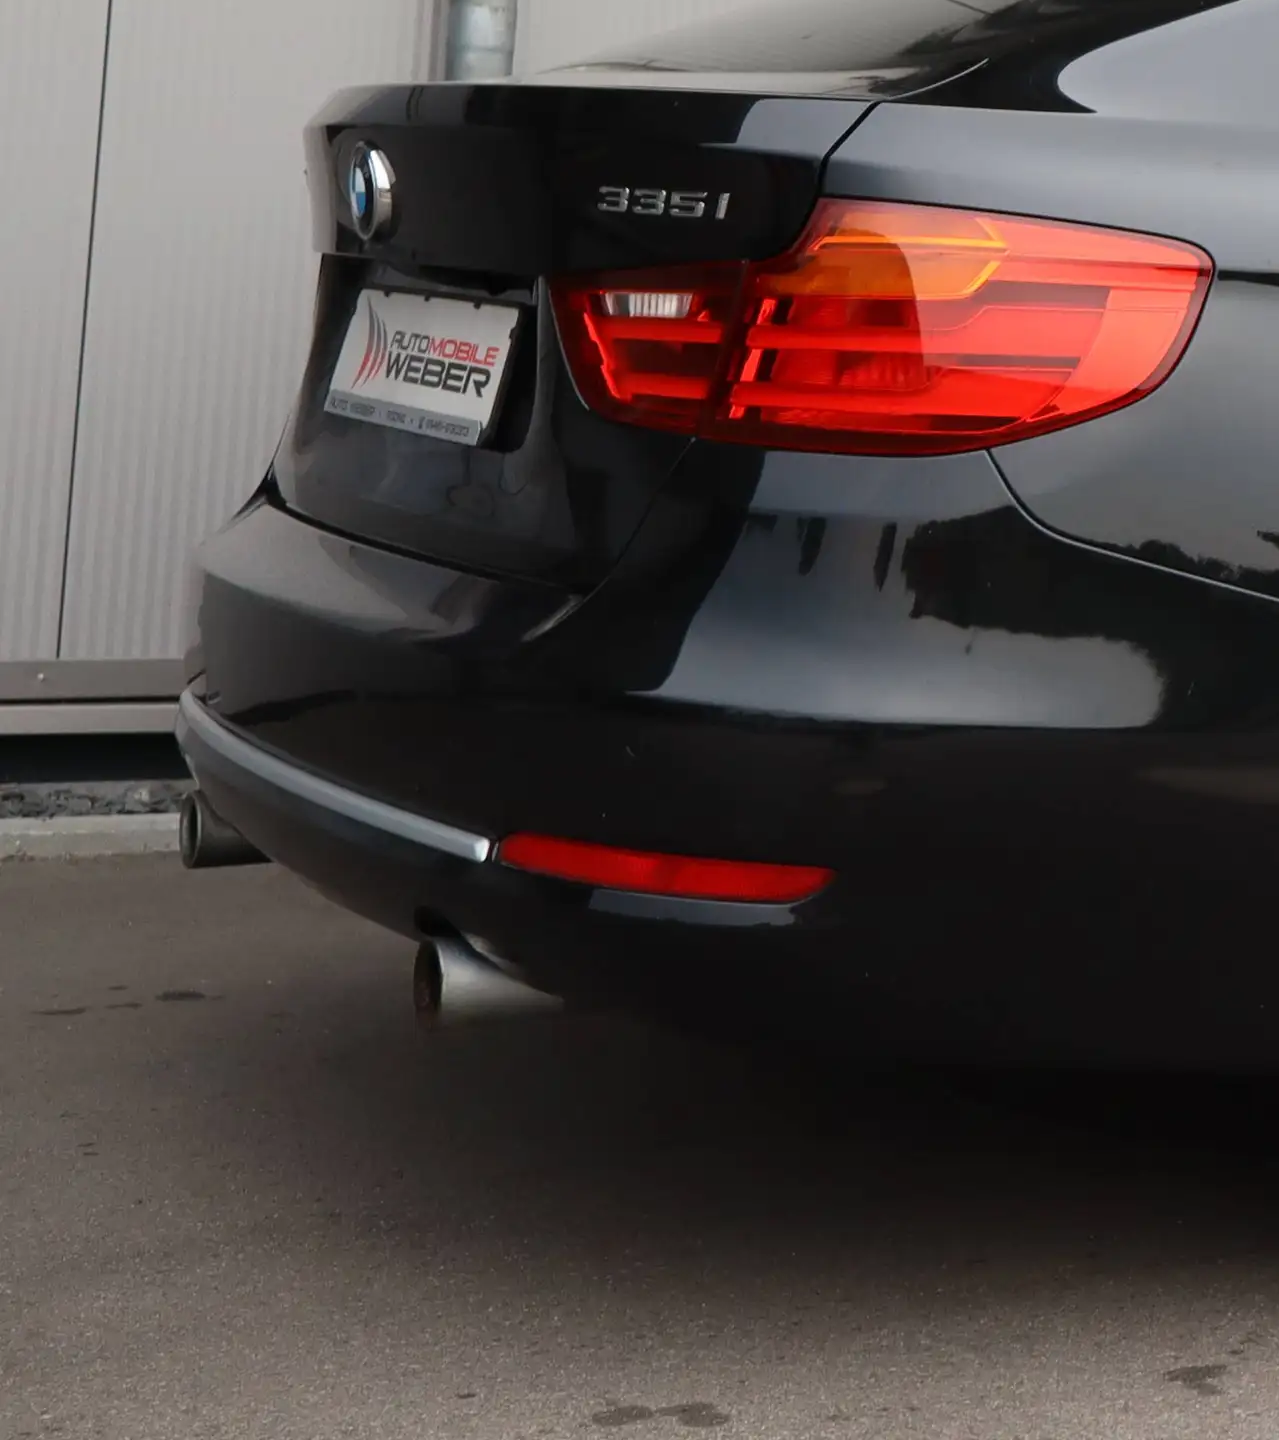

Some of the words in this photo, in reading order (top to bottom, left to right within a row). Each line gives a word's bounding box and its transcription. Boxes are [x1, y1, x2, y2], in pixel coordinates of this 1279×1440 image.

[597, 185, 731, 220] 335i
[390, 330, 500, 367] AUTOMOBILE
[385, 350, 492, 398] WEBER
